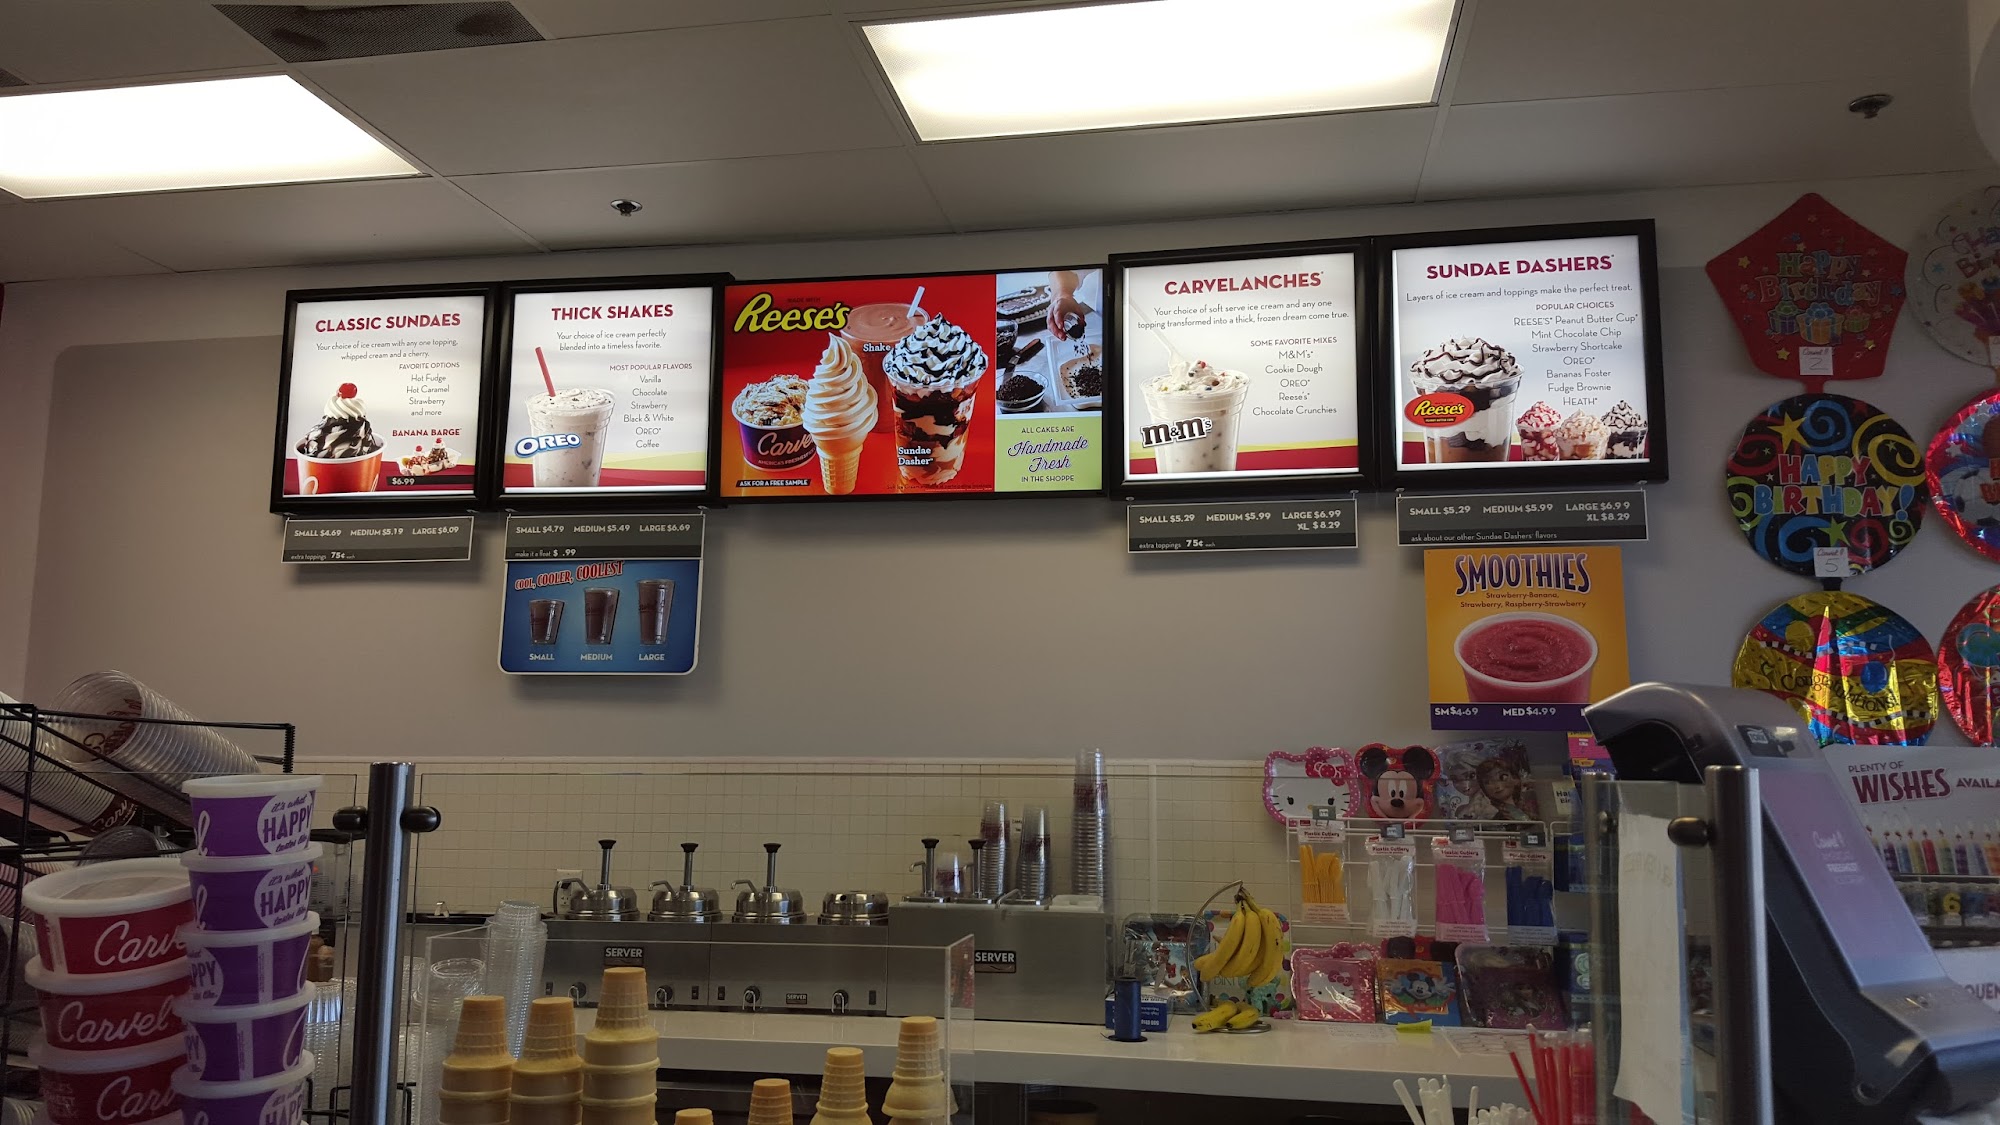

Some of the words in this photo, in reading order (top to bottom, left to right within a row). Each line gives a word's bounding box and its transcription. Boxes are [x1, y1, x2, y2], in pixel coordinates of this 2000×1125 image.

[1427, 261, 1510, 279] SUNDAE
[1776, 251, 1862, 278] Happy
[1164, 272, 1321, 295] CARVELANCHES
[1755, 275, 1883, 306] Birthday
[552, 306, 602, 320] THICK
[607, 304, 673, 319] SHAKES
[734, 293, 850, 332] Reese's
[1154, 308, 1171, 316] Your
[1173, 306, 1197, 315] choice
[1200, 305, 1207, 313] of
[1209, 304, 1223, 313] soft
[1261, 303, 1284, 311] cream
[1286, 300, 1300, 309] and
[1302, 301, 1316, 309] any
[1536, 303, 1574, 311] POPULAR
[1577, 301, 1614, 309] CHOICES
[316, 317, 381, 332] CLASSIC
[386, 314, 461, 328] SUNDAES
[1138, 320, 1165, 330] topping
[1167, 317, 1212, 327] transformed
[1213, 316, 1228, 325] into
[1257, 313, 1281, 323] frozen
[1283, 312, 1307, 321] dream
[1532, 330, 1551, 339] Mint
[1554, 329, 1597, 338] Chocolate
[1600, 328, 1621, 337] Chip
[863, 344, 891, 352] Shake
[1250, 339, 1273, 347] SOME
[1275, 338, 1311, 346] FAVORITE
[1532, 343, 1578, 353] Strawberry
[1580, 342, 1622, 351] Shortcake
[1265, 365, 1294, 374] Cookie
[1296, 363, 1322, 373] Dough
[1809, 358, 1829, 370] 2
[426, 374, 446, 383] Fudge
[640, 375, 661, 383] Vanilla
[1546, 370, 1582, 378] Bananas
[1584, 369, 1611, 377] Foster
[421, 385, 450, 393] Caramel
[1548, 383, 1574, 393] Fudge
[1577, 382, 1611, 391] Brownie
[409, 397, 445, 406] Strawberry
[631, 402, 667, 410] Strawberry
[1414, 400, 1465, 416] Reese's
[1253, 407, 1294, 416] Chocolate
[1296, 405, 1337, 415] Crunchies
[624, 414, 642, 422] Black
[652, 414, 674, 422] White
[392, 429, 428, 437] BANANA
[516, 434, 580, 456] OREO
[636, 440, 659, 448] Coffee
[758, 433, 813, 456] Carve
[1008, 435, 1088, 456] Handmade
[898, 447, 931, 455] Sundae
[1029, 455, 1070, 472] Fresh
[1777, 454, 1871, 486] HAPPY
[1410, 507, 1441, 516] SMALL
[1443, 505, 1471, 515] $5.29
[1483, 505, 1523, 513] MEDIUM
[1525, 504, 1553, 513] $5.99
[1566, 503, 1598, 511] LARGE
[1600, 502, 1630, 511] $6.99
[1754, 484, 1914, 521] BIRTHDAY!
[1139, 515, 1168, 524] SMALL
[1170, 514, 1195, 523] $5.29
[1206, 513, 1242, 522] MEDIUM
[1245, 512, 1271, 522] $5.99
[1282, 511, 1312, 520] LARGE
[1314, 510, 1341, 520] $6.99
[1586, 513, 1599, 522] XL
[1601, 513, 1630, 521] $8.29
[382, 528, 403, 536] $5.19
[607, 525, 630, 533] $5.49
[667, 524, 690, 532] $6.69
[577, 561, 624, 580] COOLEST
[1825, 559, 1838, 572] 5
[1455, 553, 1591, 596] SMOOTHIES
[1781, 674, 1900, 712] Congratulations!
[1450, 707, 1478, 715] $4.69
[1526, 707, 1556, 715] $4.99
[1848, 762, 1886, 772] PLENTY
[1889, 761, 1904, 769] OF
[1852, 768, 1950, 803] WISHES
[263, 803, 312, 843] HAPPY
[261, 876, 311, 917] HAPPY
[95, 920, 187, 966] Carv
[606, 948, 642, 957] SERVER
[975, 952, 1014, 962] SERVER
[58, 996, 175, 1043] Carvel
